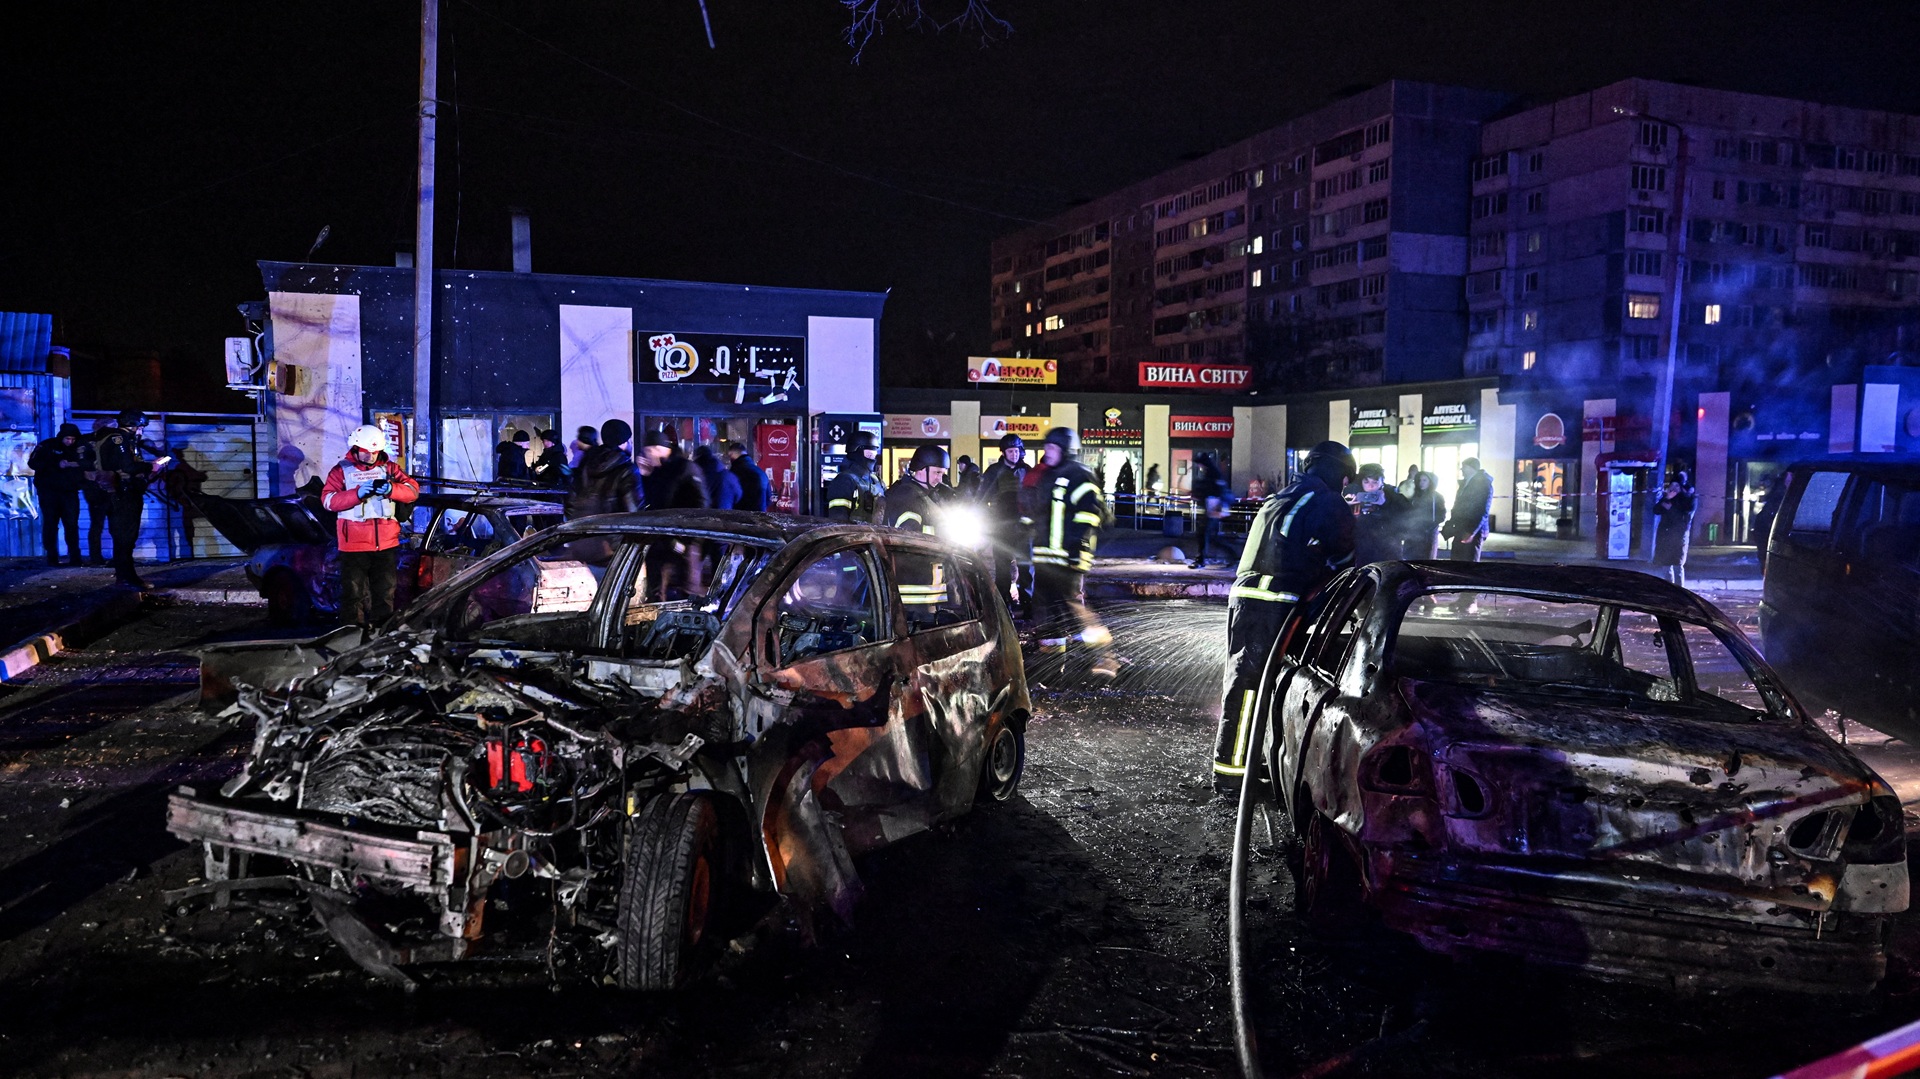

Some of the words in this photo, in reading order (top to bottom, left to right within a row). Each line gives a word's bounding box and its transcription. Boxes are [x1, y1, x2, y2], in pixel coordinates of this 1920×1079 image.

[662, 371, 678, 379] PIZZA
[985, 362, 1045, 378] АВРОРА
[1147, 367, 1196, 383] ВИНА
[1200, 368, 1248, 384] СВІТУ
[1358, 409, 1387, 419] АПТЕКА
[1433, 404, 1466, 415] АПТЕКА
[995, 421, 1039, 432] АВРОРА
[1174, 422, 1203, 432] ВИНА
[1204, 422, 1233, 432] СВІТУ
